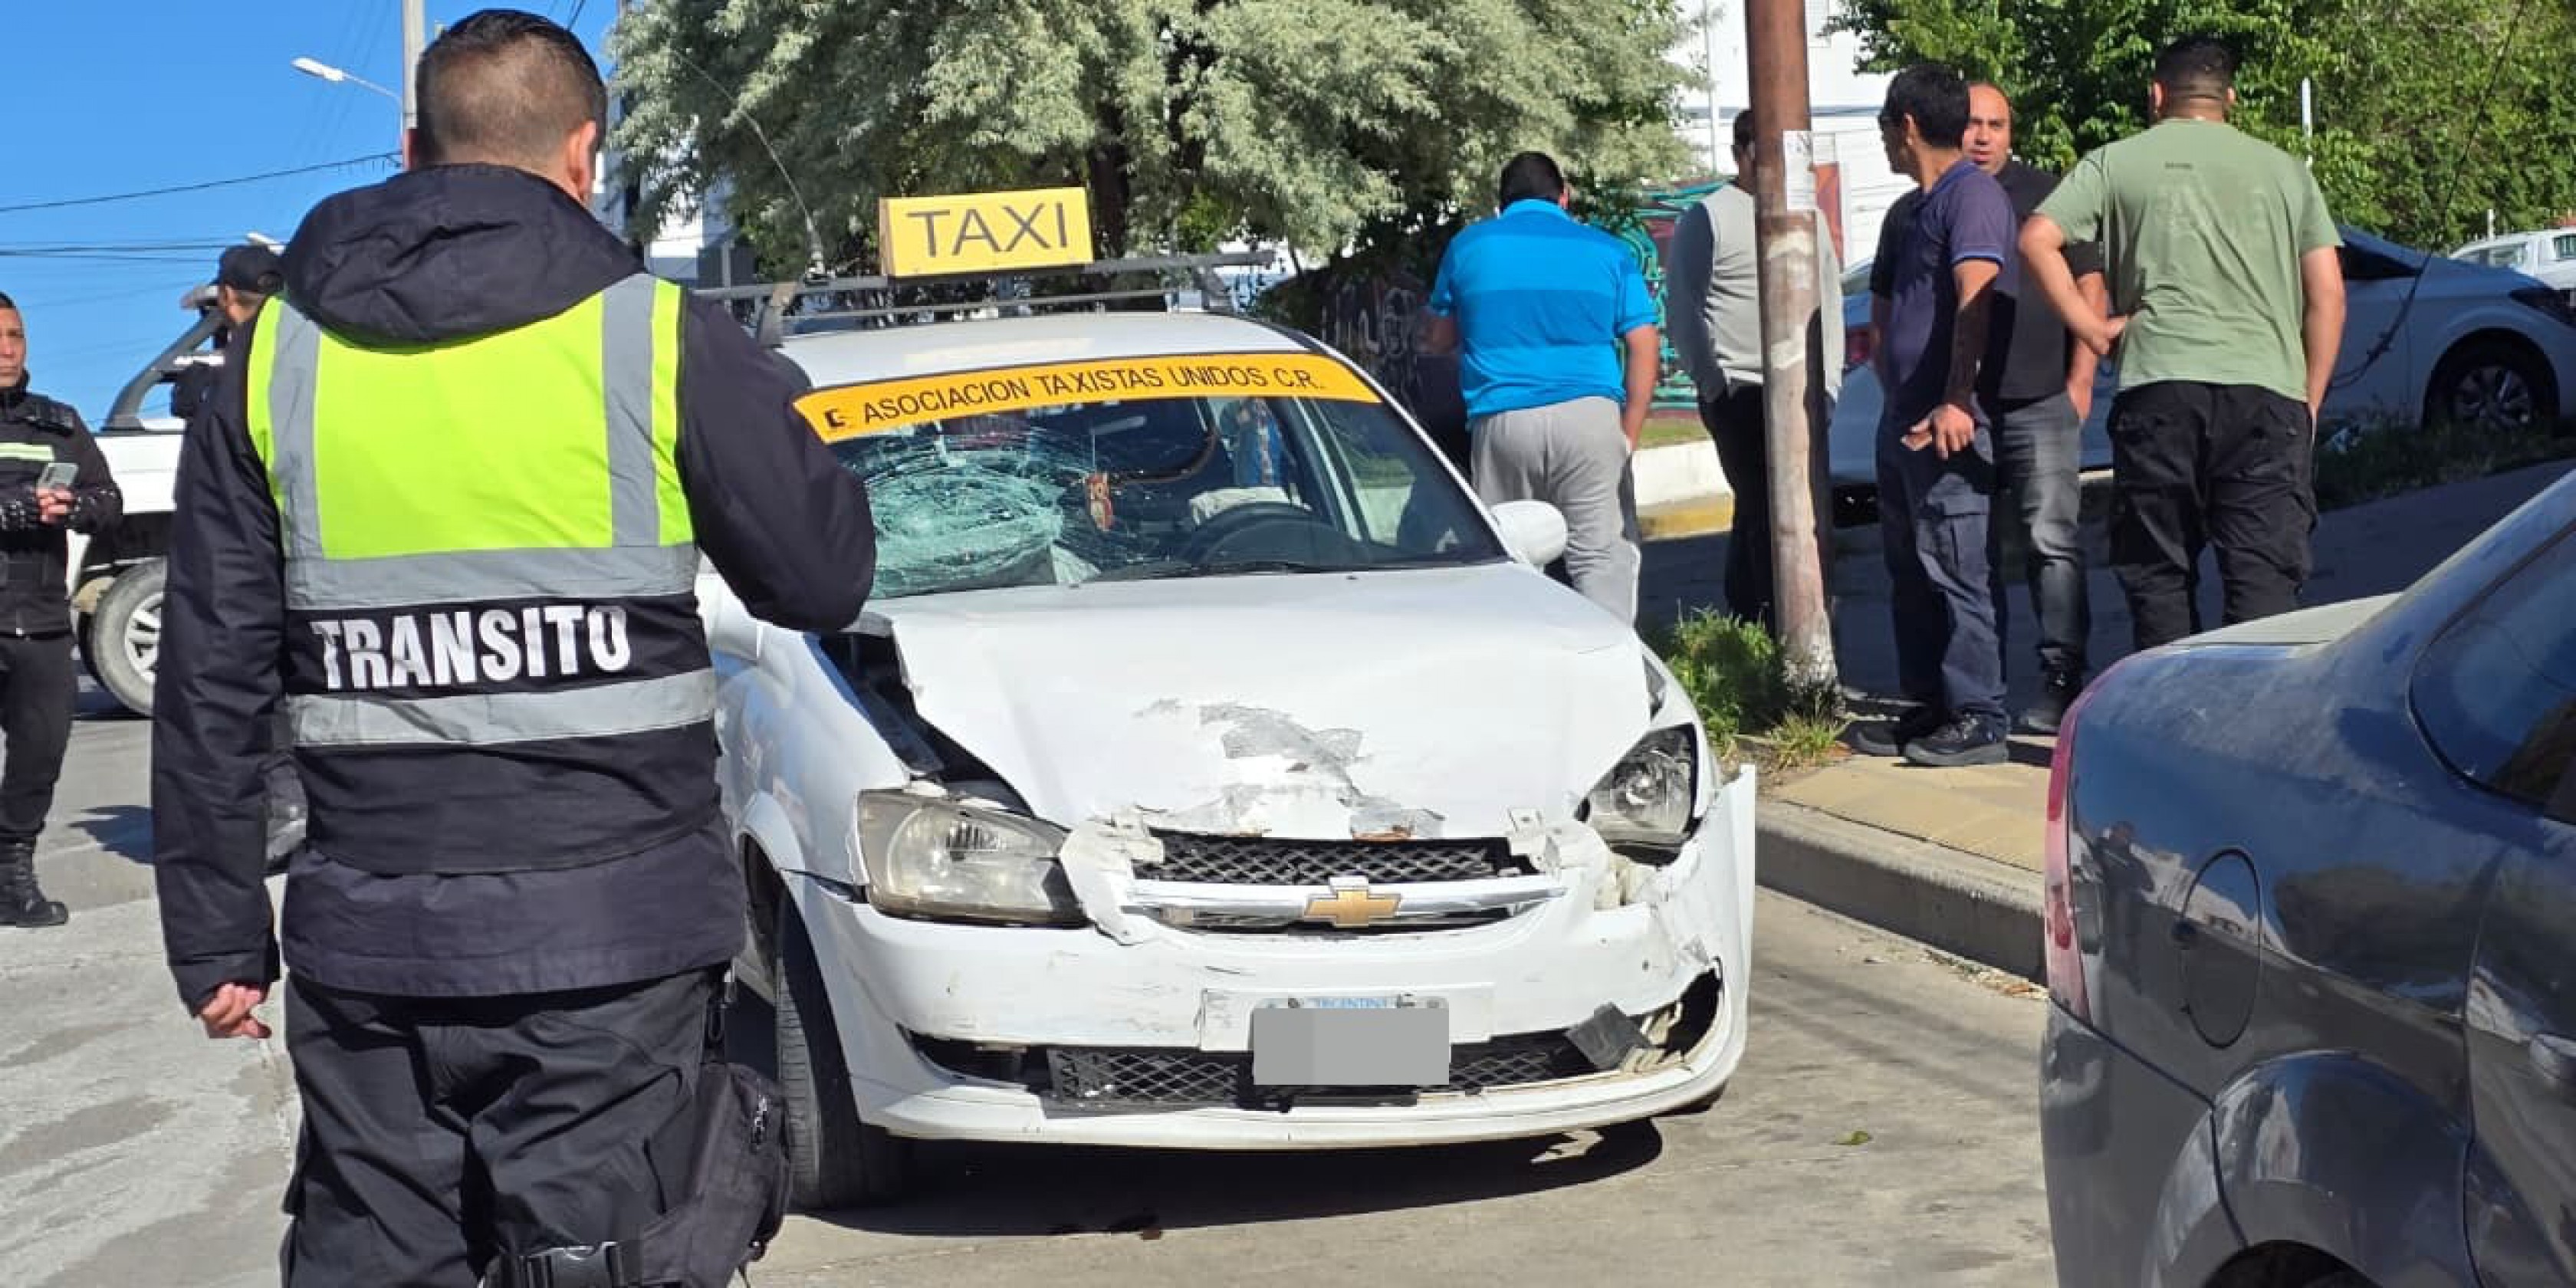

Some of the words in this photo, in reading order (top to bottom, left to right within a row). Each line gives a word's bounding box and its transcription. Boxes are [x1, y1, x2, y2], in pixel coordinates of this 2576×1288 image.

[905, 202, 1068, 258] TAXI
[864, 378, 1031, 424] ASOCIACION
[1033, 367, 1164, 396] TAXISTAS
[1166, 366, 1267, 387] UNIDOS
[310, 606, 632, 689] TRANSITO
